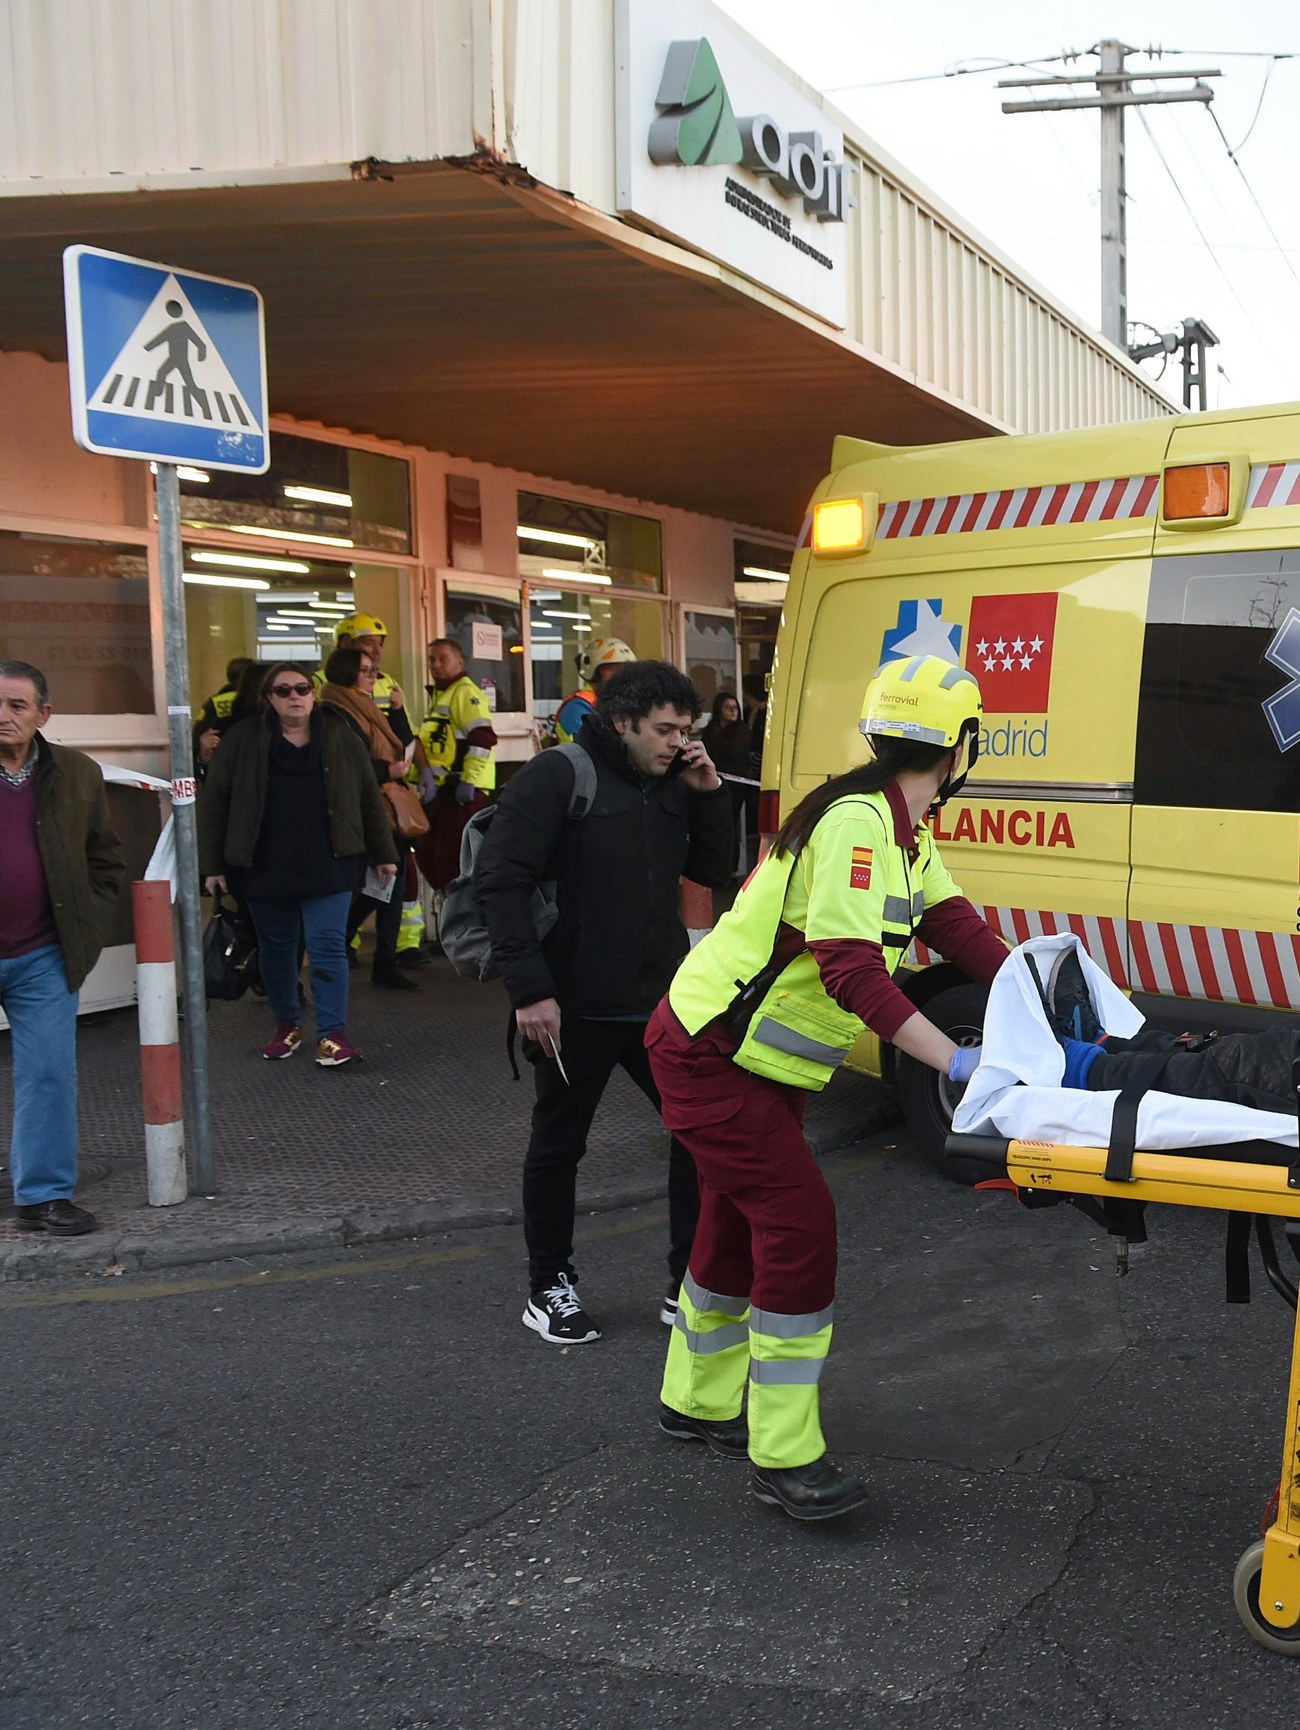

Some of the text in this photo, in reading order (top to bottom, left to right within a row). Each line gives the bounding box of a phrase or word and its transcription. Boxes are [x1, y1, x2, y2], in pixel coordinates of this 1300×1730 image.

[880, 691, 919, 706] ferrovial
[978, 720, 1048, 758] adrid
[931, 807, 1076, 849] LANCIA
